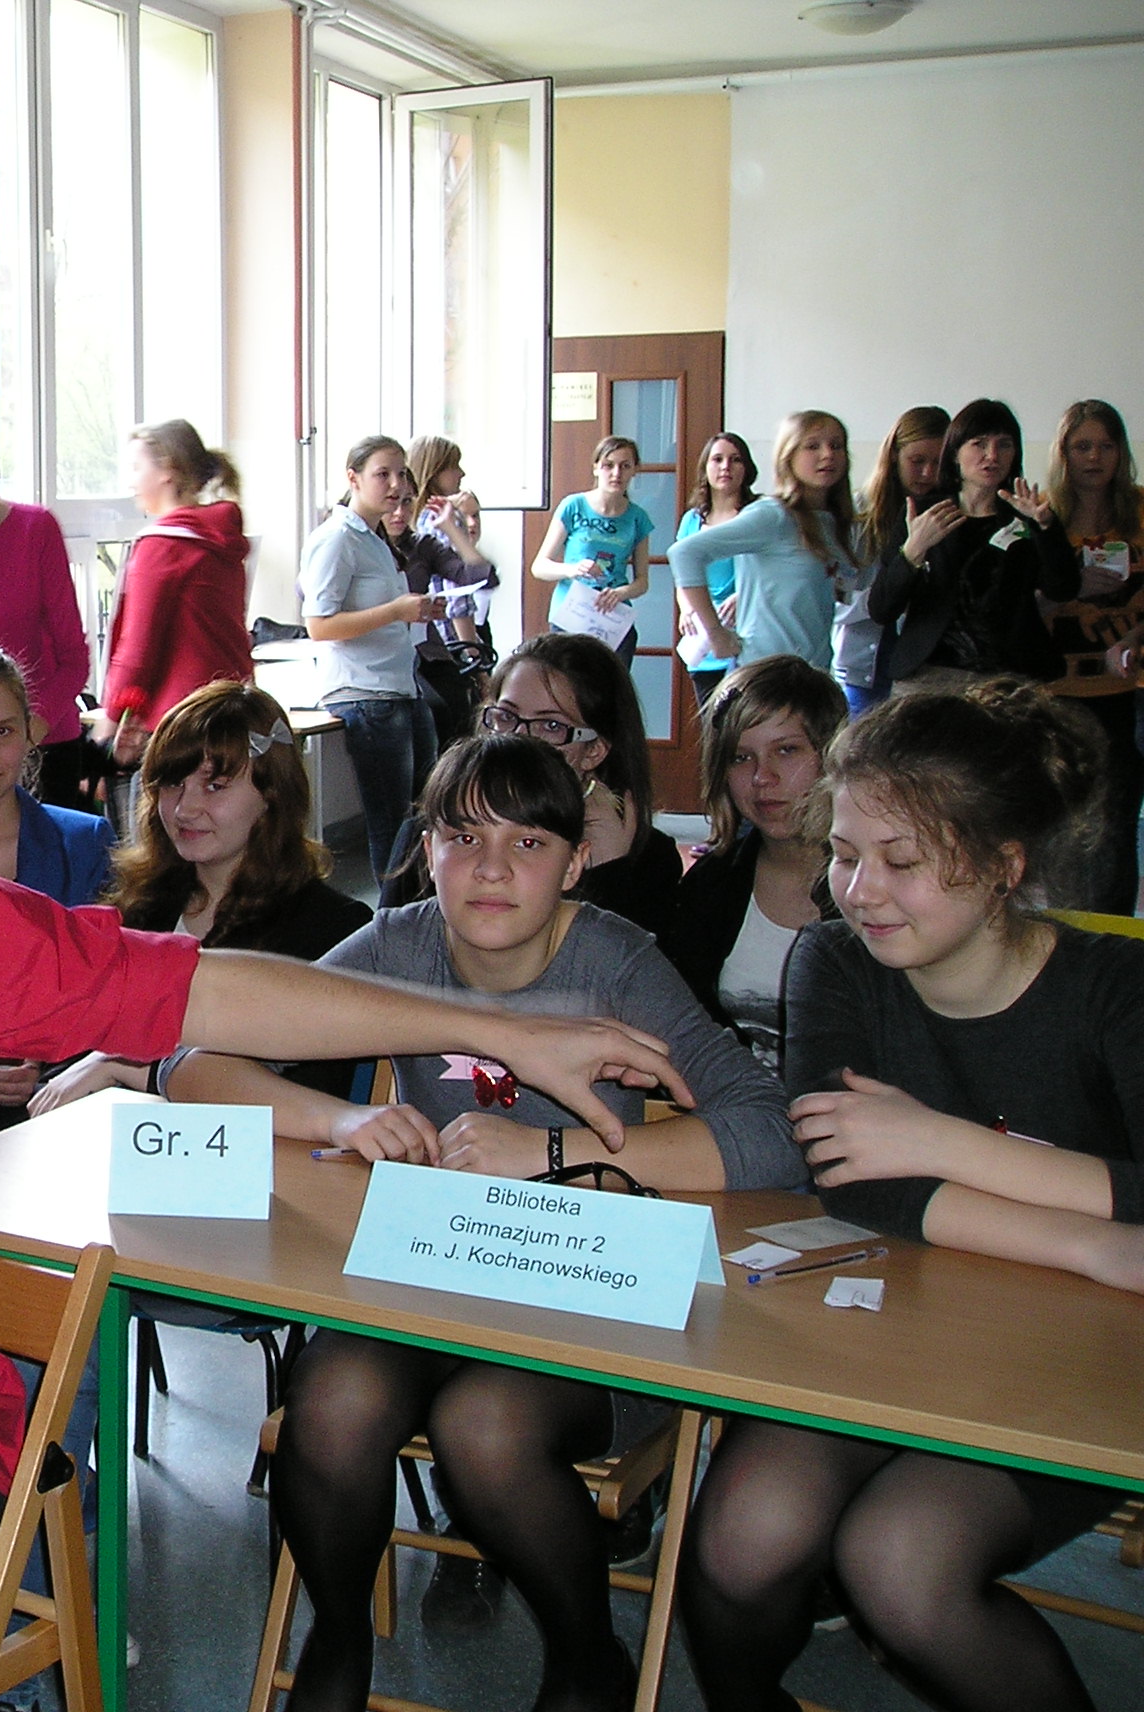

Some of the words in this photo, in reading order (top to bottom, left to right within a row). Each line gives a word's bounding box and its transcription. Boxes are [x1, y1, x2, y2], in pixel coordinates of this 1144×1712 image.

[132, 1121, 190, 1157] Gr.
[205, 1124, 229, 1158] 4
[486, 1186, 581, 1216] Biblioteka
[449, 1214, 560, 1247] Gimnazjum
[565, 1236, 588, 1251] nr
[591, 1235, 606, 1254] 2
[409, 1237, 437, 1257] im.
[444, 1243, 460, 1260] J.
[467, 1245, 638, 1290] Kochanowskiego
